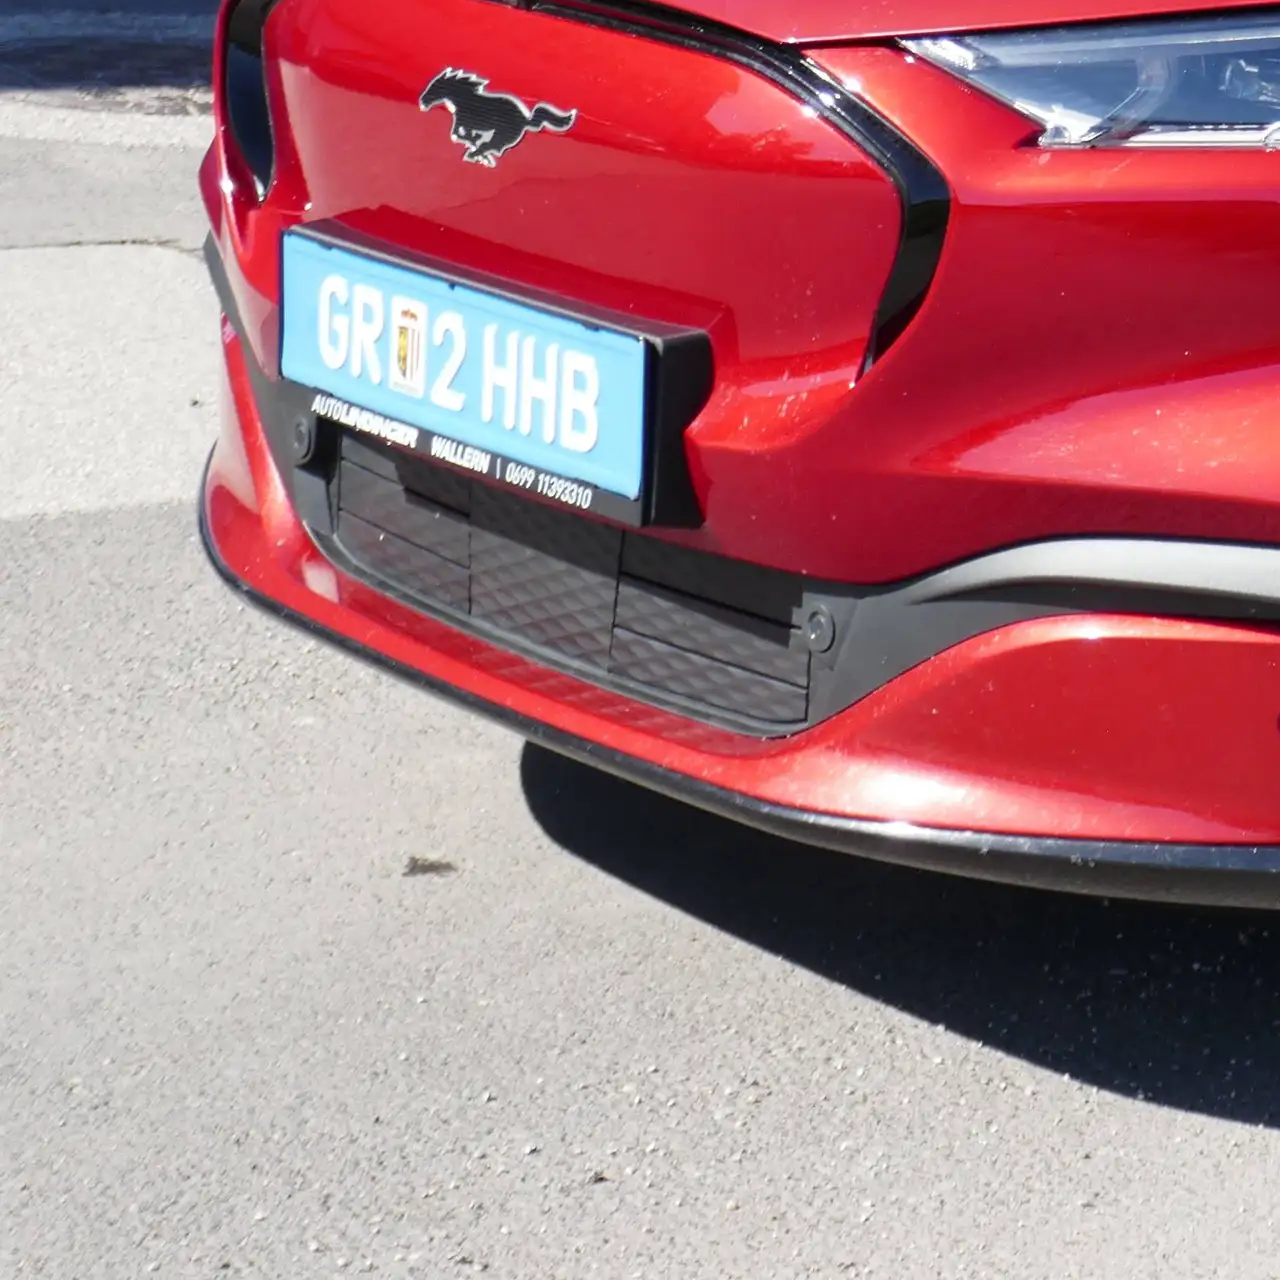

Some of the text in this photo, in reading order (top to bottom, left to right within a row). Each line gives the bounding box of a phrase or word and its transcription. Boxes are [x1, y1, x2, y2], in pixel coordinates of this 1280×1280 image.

[318, 276, 600, 453] GR 2 HHB
[430, 436, 491, 474] WALLERN
[505, 462, 535, 490] 0699
[536, 469, 593, 510] 11393310
